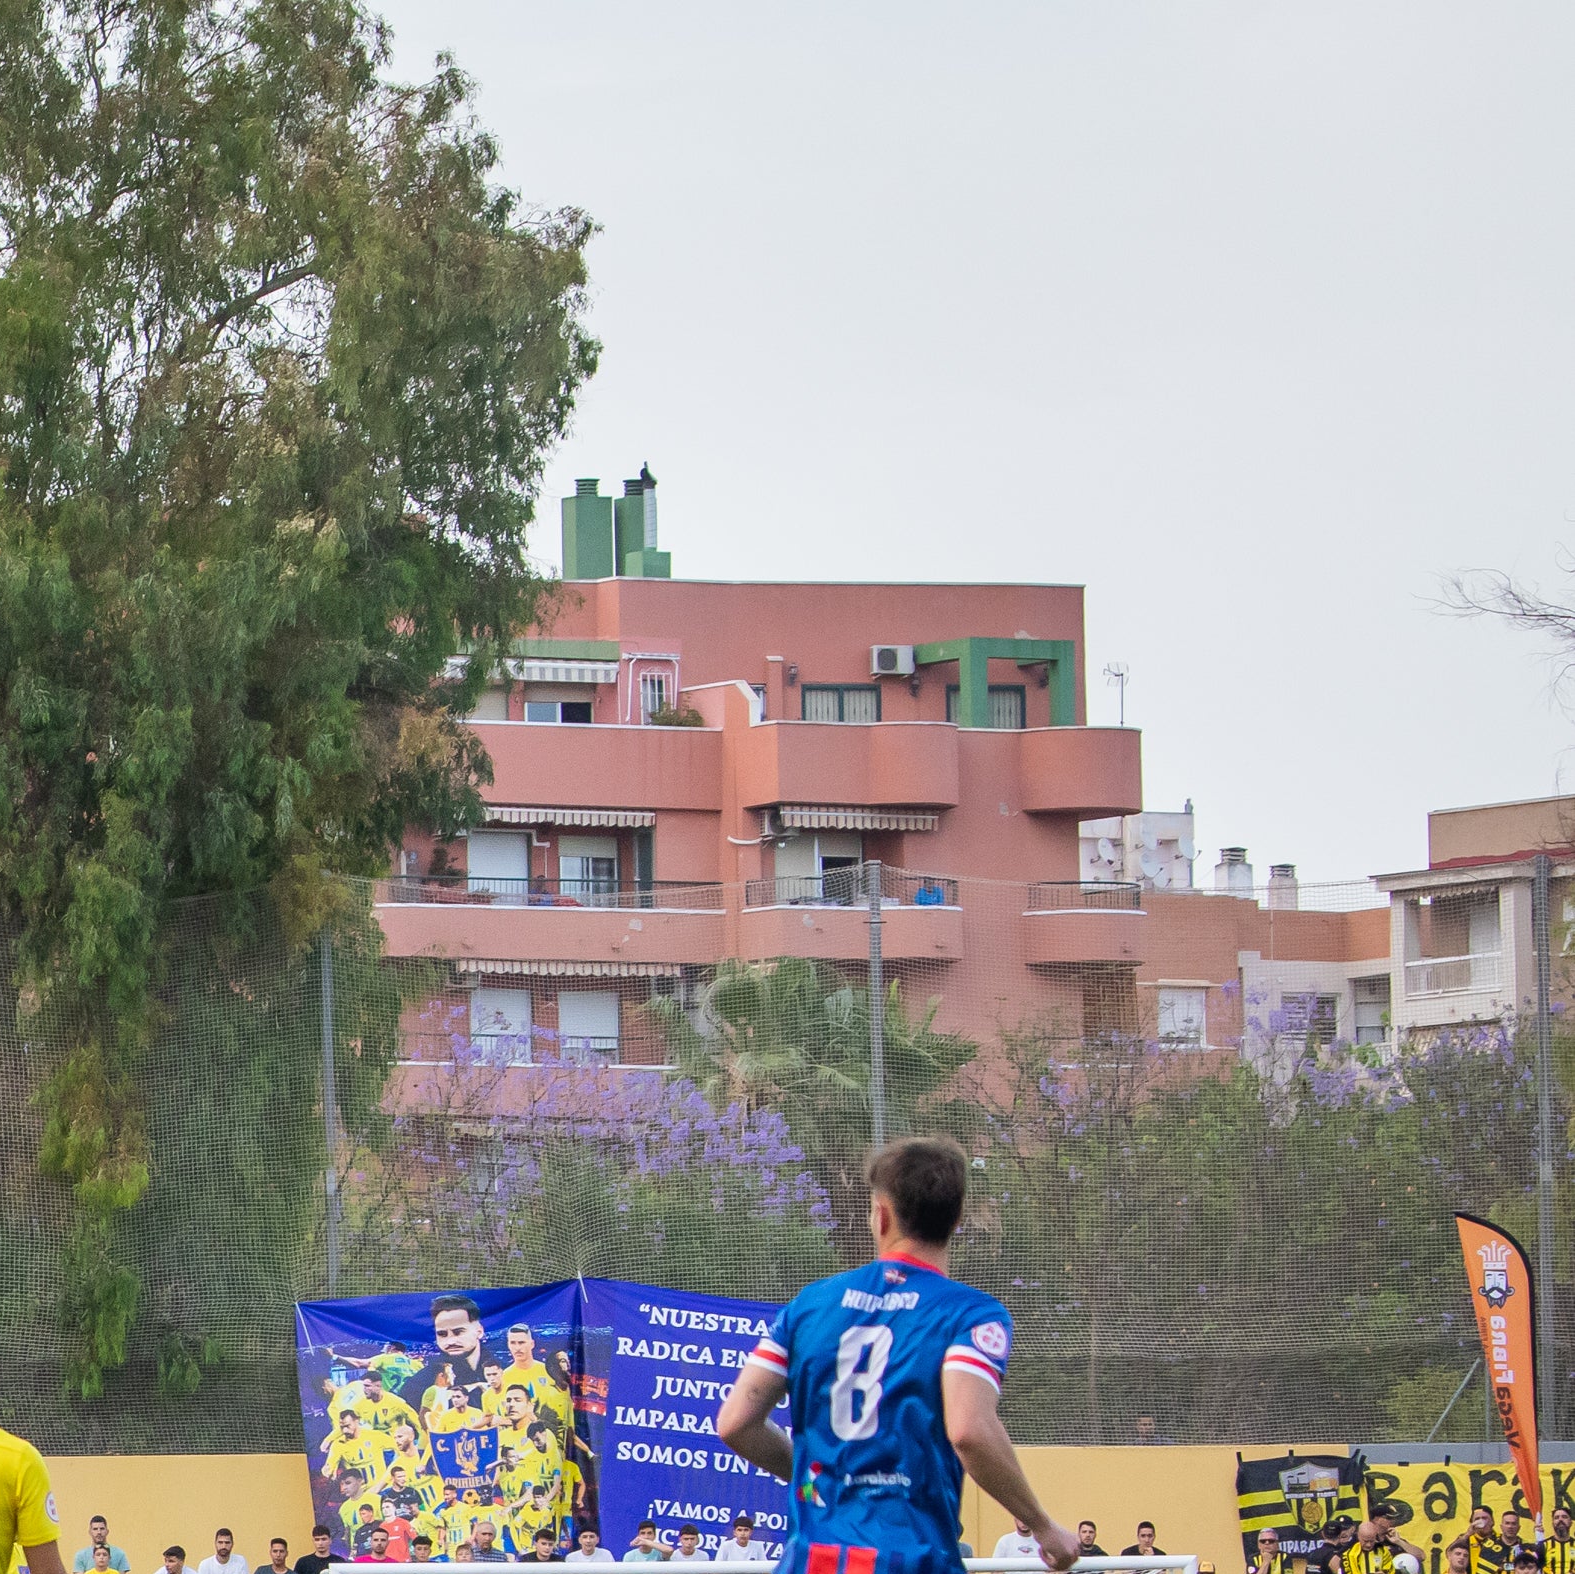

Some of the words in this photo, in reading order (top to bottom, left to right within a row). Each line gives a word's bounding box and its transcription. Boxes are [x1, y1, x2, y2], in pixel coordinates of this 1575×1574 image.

[616, 1337, 715, 1366] RADICA
[830, 1324, 894, 1441] 8
[616, 1441, 709, 1470] SOMOS
[713, 1452, 750, 1477] UN
